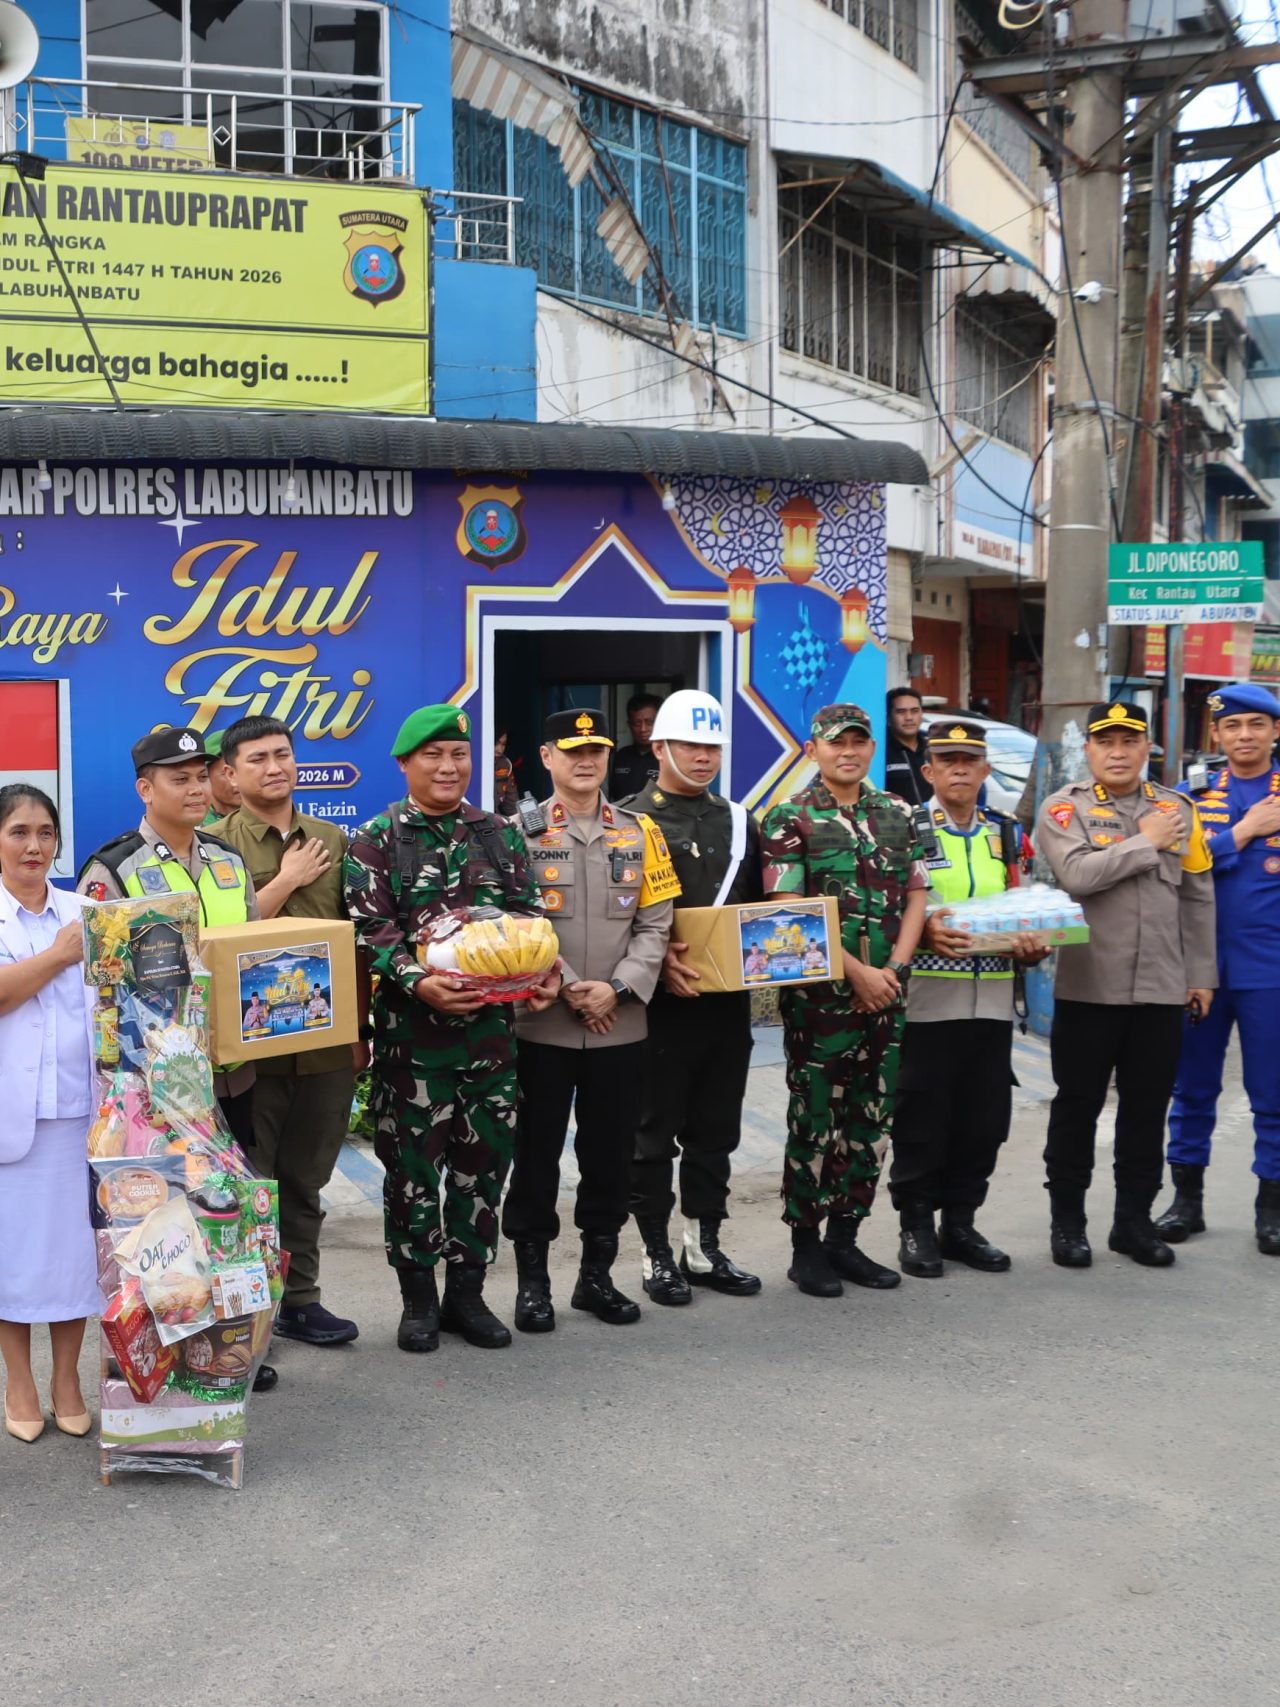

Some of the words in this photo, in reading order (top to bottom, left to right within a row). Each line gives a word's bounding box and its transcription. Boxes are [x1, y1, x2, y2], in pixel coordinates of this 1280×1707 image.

[57, 185, 308, 232] RANTAUPRAPAT
[342, 213, 380, 225] SUMATERA
[382, 216, 405, 229] UTARA
[24, 233, 106, 250] RANGKA
[47, 260, 95, 275] FTRI
[102, 262, 145, 277] 1447
[151, 264, 164, 278] H
[170, 265, 233, 281] TAHUN
[239, 269, 282, 284] 2026
[6, 346, 151, 383] keluarga
[159, 351, 288, 388] bahagia
[54, 467, 176, 517] POLRES
[184, 468, 414, 518] LABUHANBATU
[142, 538, 379, 645] Idul
[1128, 586, 1148, 600] Kec
[1156, 586, 1197, 600] Rantau
[1206, 585, 1240, 599] Utara
[1155, 608, 1184, 621] JALA
[149, 642, 375, 741] Fitri
[691, 707, 723, 732] PM
[298, 769, 330, 783] 2026
[332, 768, 345, 782] M
[307, 801, 358, 817] Faizin
[532, 850, 570, 860] SONNY
[608, 851, 642, 862] PLRI
[129, 1189, 161, 1197] COOKIES
[139, 1237, 165, 1273] OAT
[161, 1234, 191, 1270] CHOCO
